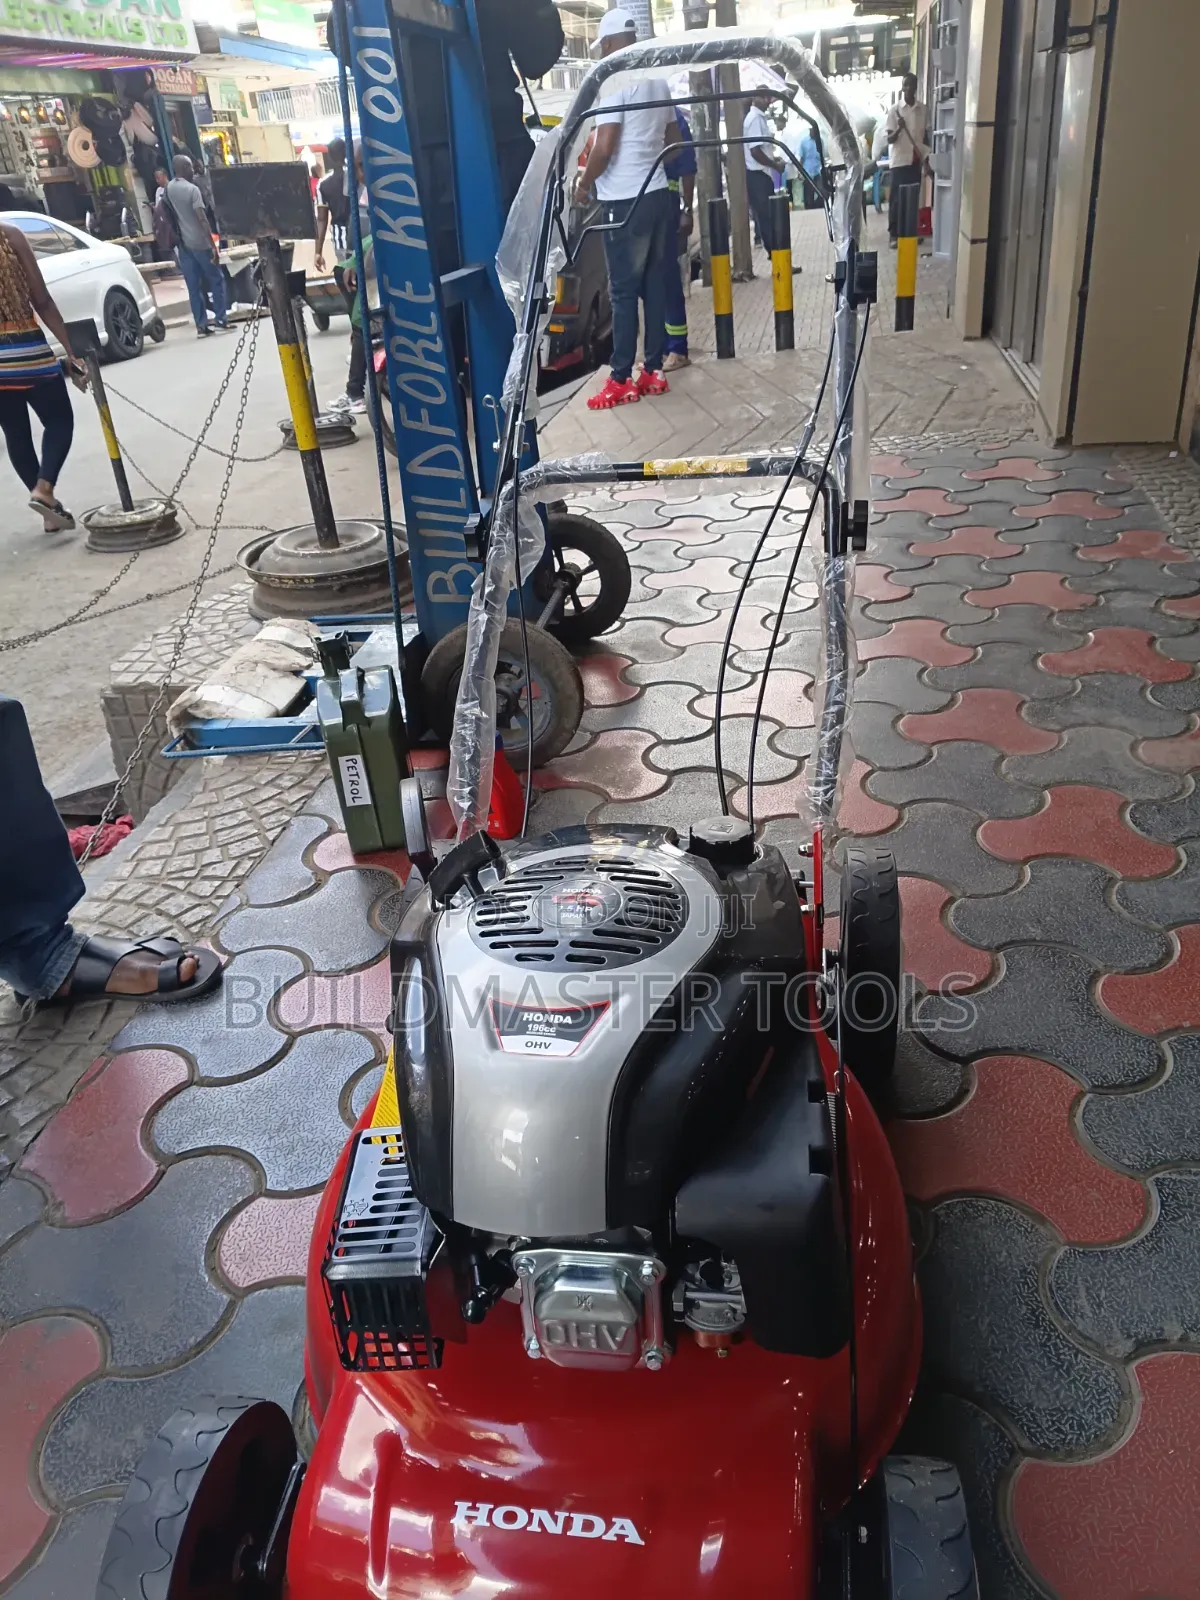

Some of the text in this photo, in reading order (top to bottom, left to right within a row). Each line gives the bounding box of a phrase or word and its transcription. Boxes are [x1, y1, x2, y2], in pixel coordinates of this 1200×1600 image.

[0, 0, 189, 47] ECTRICALS LTD
[366, 138, 428, 251] KDV
[388, 280, 484, 603] BUILDFORCE
[345, 757, 363, 803] PETROL
[522, 1012, 573, 1024] HONDA
[527, 1023, 557, 1033] 196cc
[525, 1040, 552, 1050] OHV
[542, 1320, 628, 1352] OHV
[450, 1501, 645, 1546] HONDA
